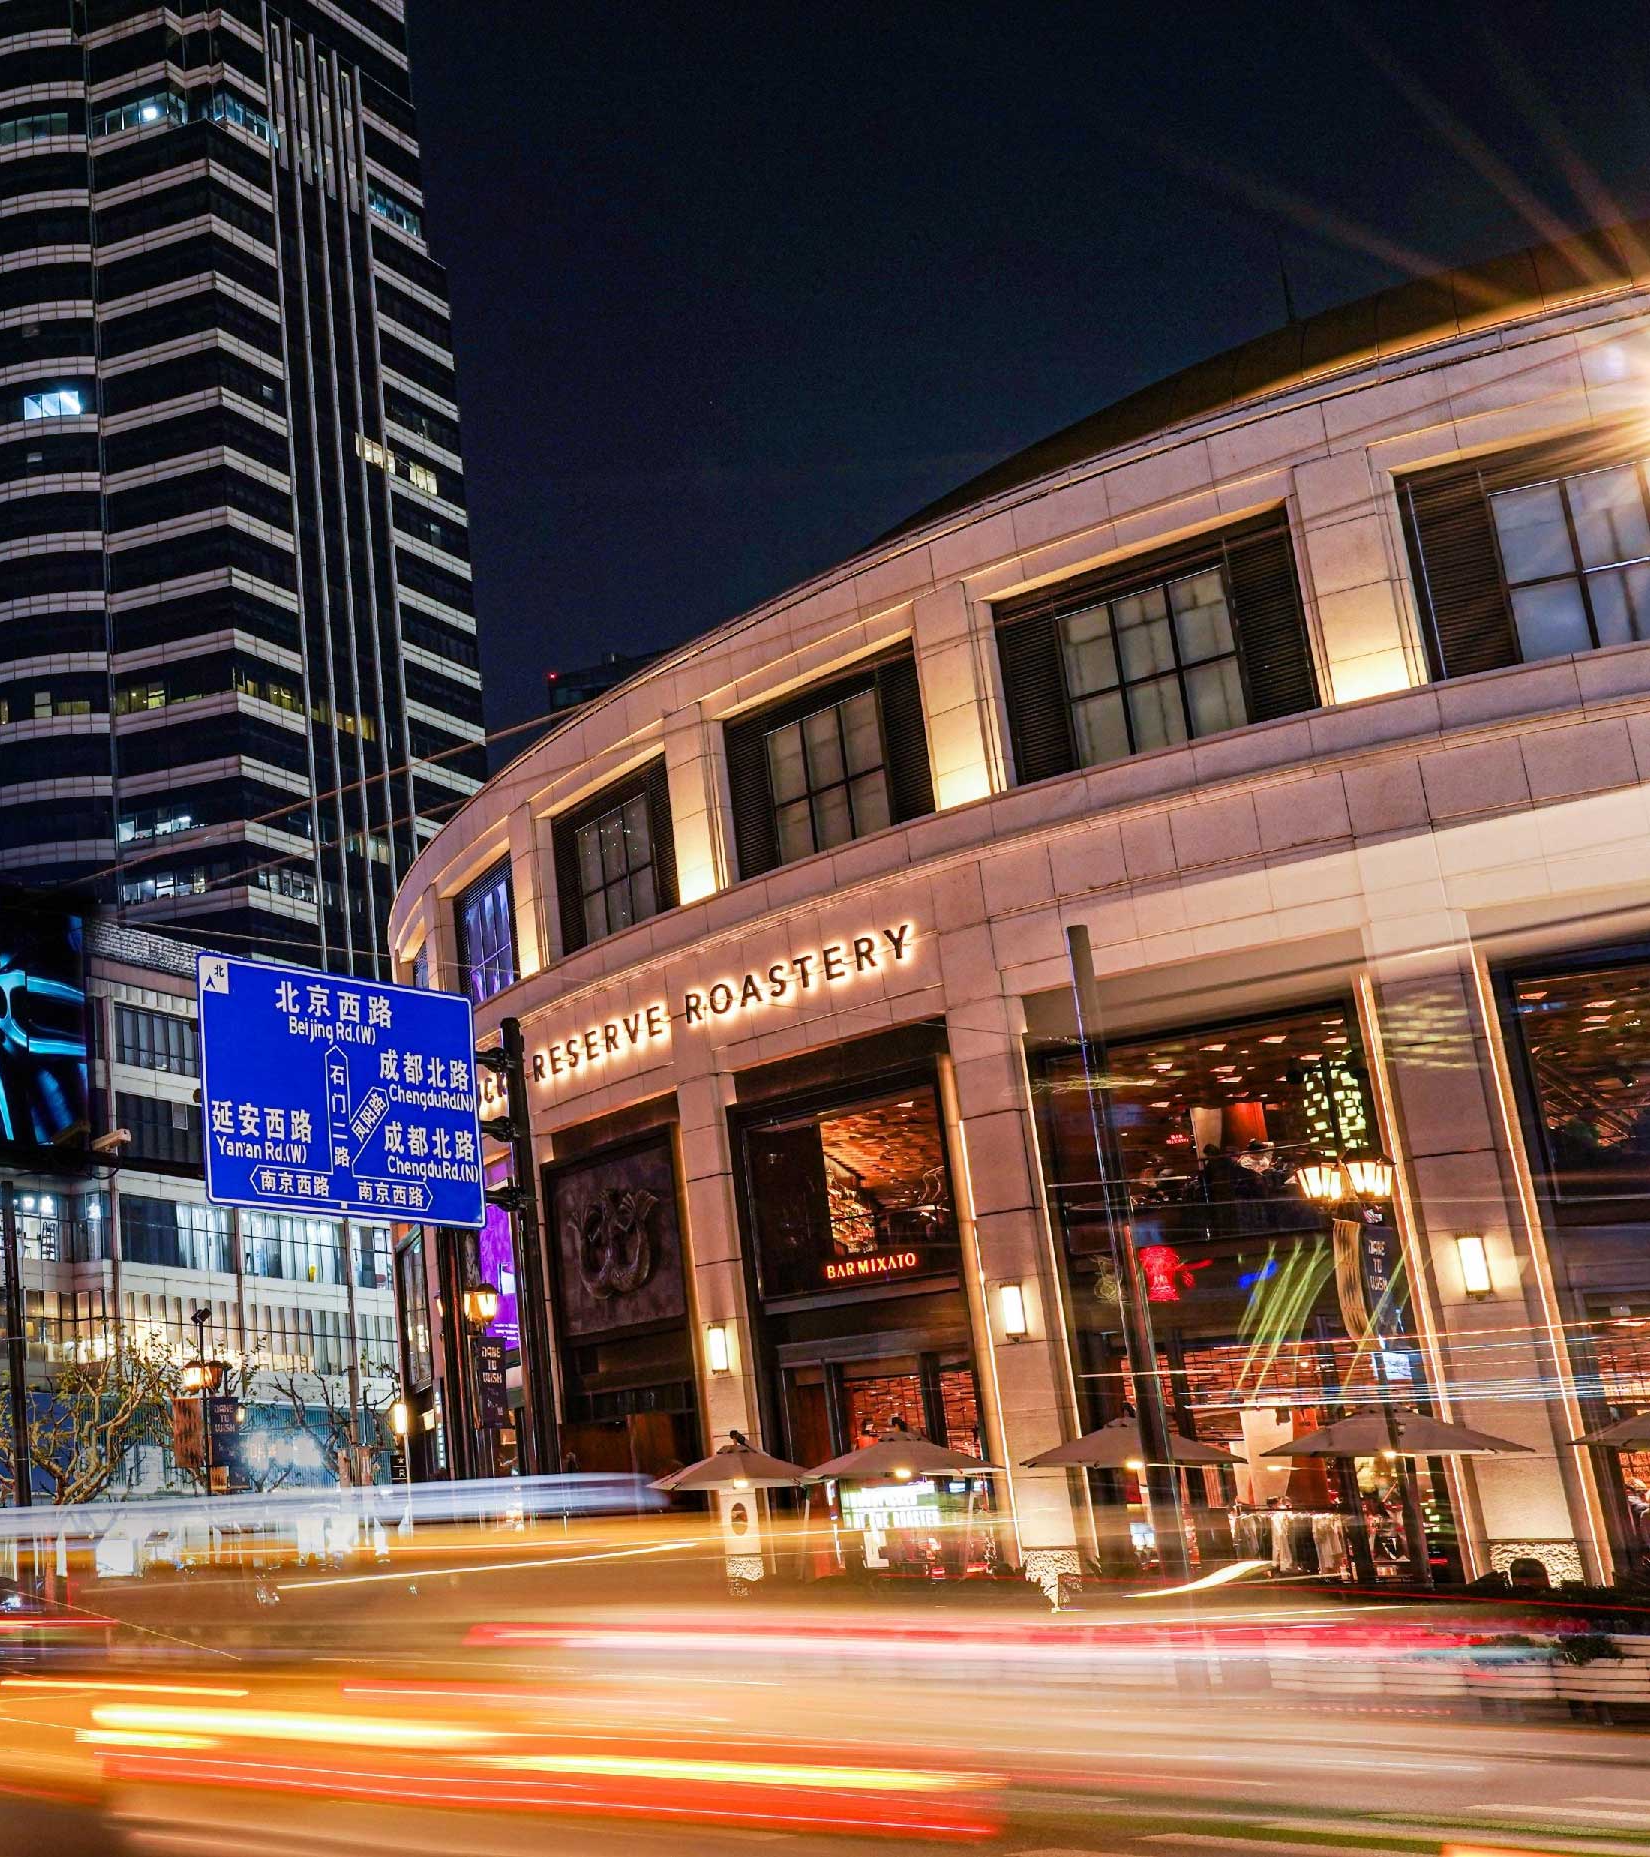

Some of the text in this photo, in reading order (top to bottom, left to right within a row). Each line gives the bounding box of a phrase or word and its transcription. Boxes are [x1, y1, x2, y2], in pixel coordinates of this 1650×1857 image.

[214, 964, 225, 978] 北
[275, 980, 393, 1029] 北京西路
[531, 925, 910, 1083] RESERVE ROASTERY
[288, 1015, 376, 1045] Beijing Rd.(W)
[379, 1048, 469, 1092] 成都北路
[211, 1099, 312, 1144] 延安西路
[329, 1064, 350, 1168] 石门二路
[351, 1092, 387, 1143] 凤阳路
[216, 1135, 307, 1164] Yan'an Rd.(W)
[384, 1120, 475, 1163] 成都北路
[259, 1169, 330, 1197] 南京西路
[357, 1180, 424, 1208] 南京西路
